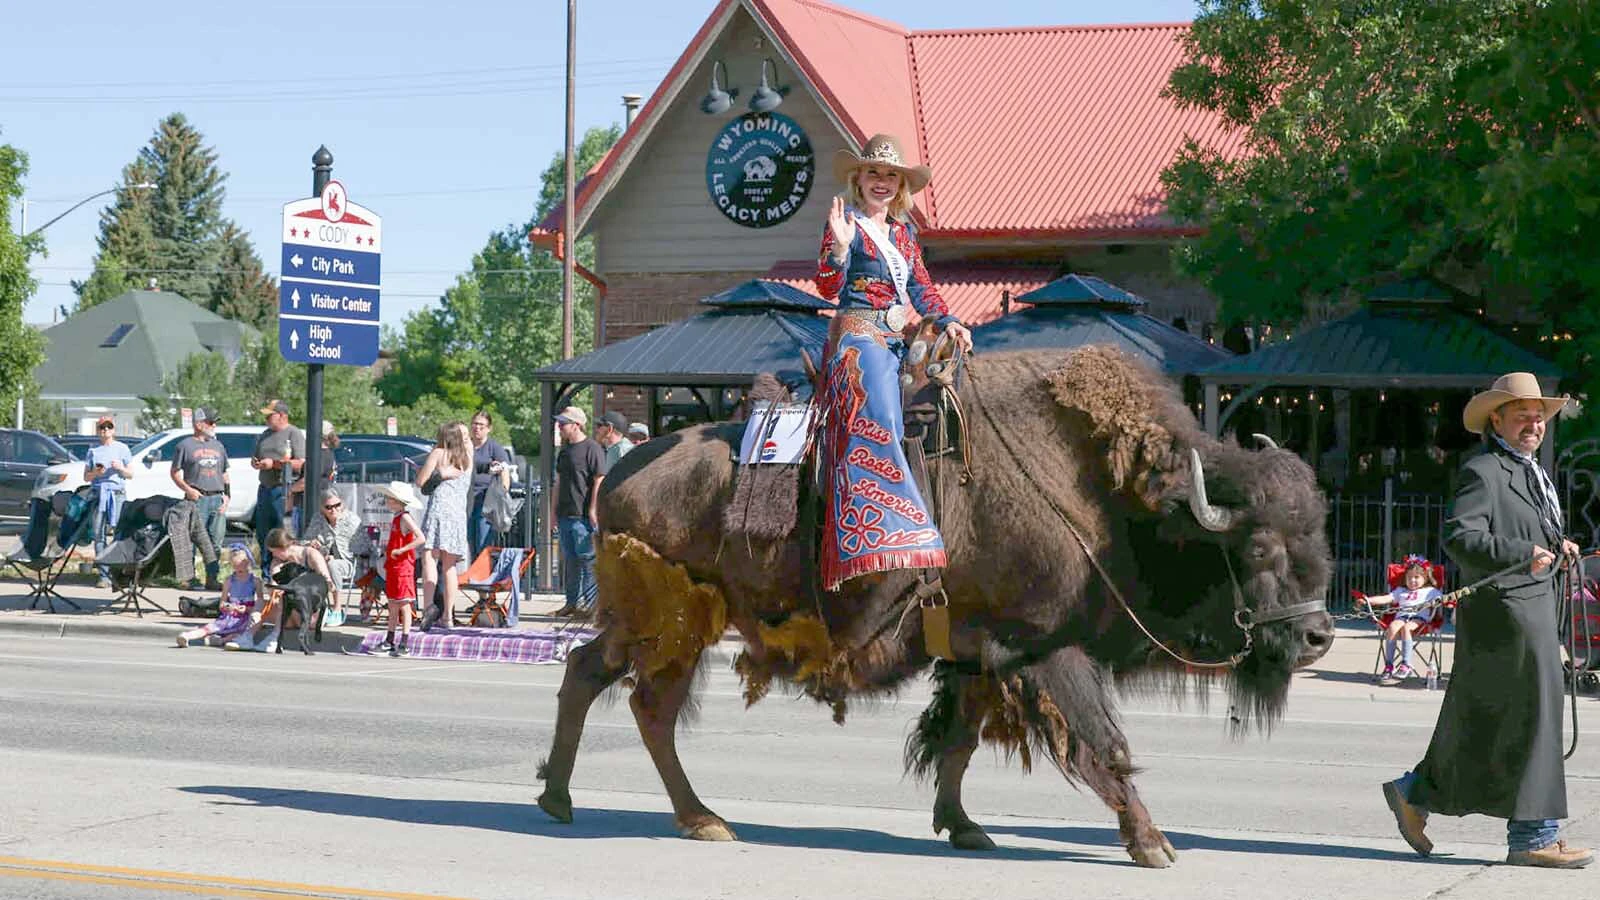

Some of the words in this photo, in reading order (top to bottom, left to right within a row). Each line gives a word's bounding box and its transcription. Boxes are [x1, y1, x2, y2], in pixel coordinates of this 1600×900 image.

[718, 118, 801, 151] WYOMING
[712, 173, 760, 221] LEGACY
[766, 170, 808, 221] MEATS
[318, 224, 349, 244] CODY
[311, 256, 331, 275] City
[333, 259, 355, 275] Park
[310, 293, 340, 310] Visitor
[342, 296, 372, 313] Center
[309, 324, 332, 343] High
[309, 344, 341, 359] School
[767, 415, 780, 439] 1
[851, 417, 892, 445] Miss
[849, 447, 904, 484] Rodeo
[852, 478, 928, 526] America
